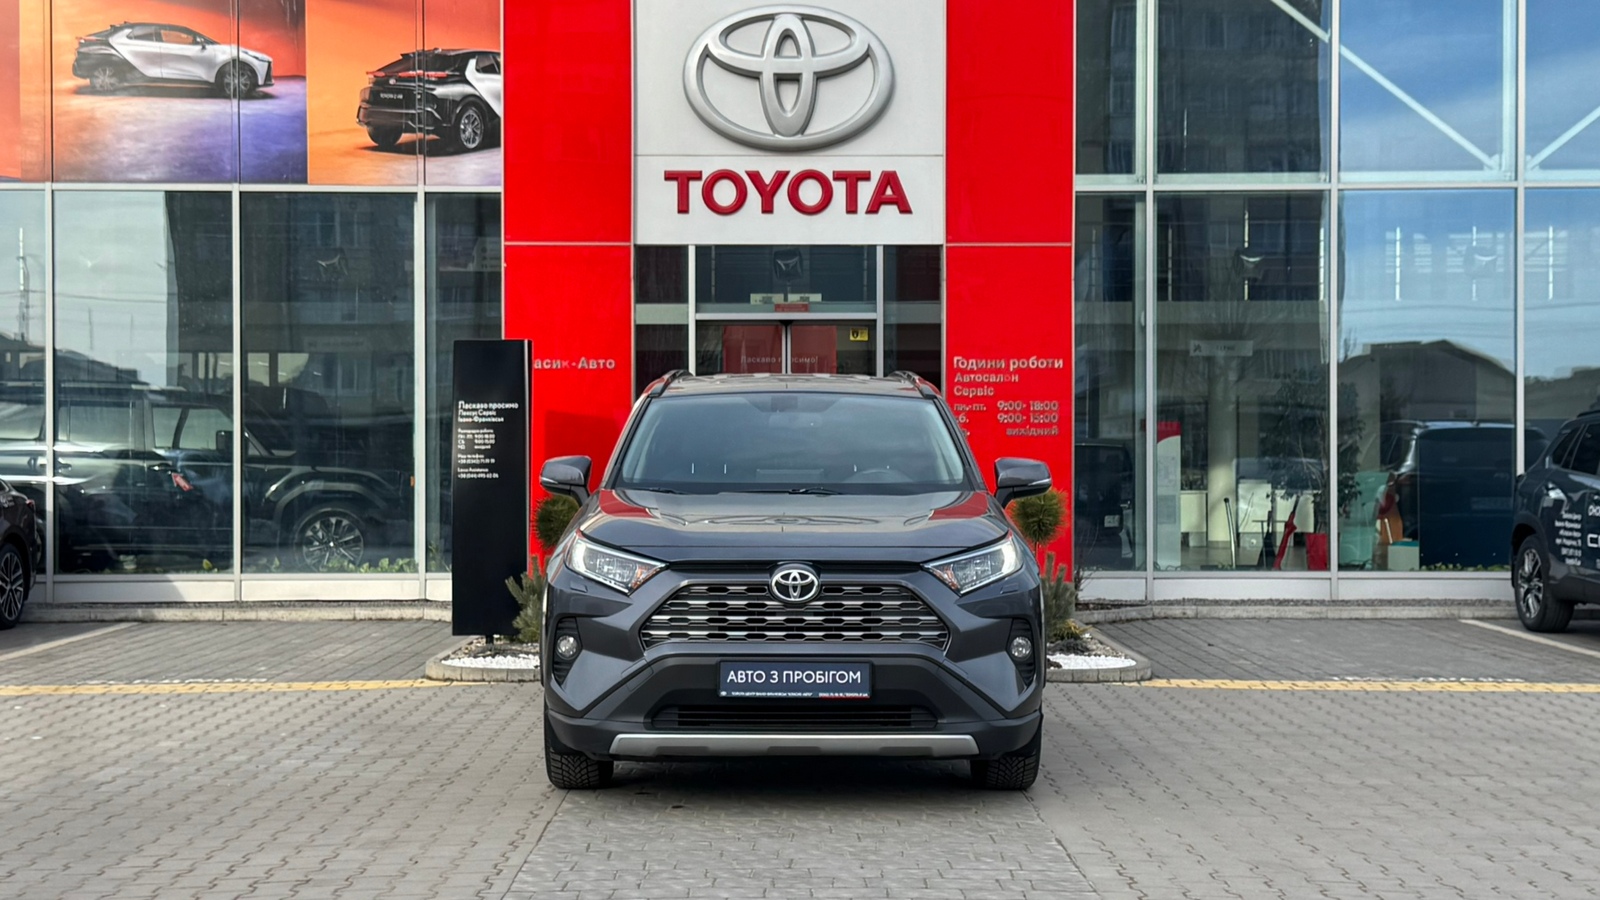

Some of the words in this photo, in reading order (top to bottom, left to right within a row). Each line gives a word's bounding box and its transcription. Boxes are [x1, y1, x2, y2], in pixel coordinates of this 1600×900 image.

[664, 169, 913, 216] TOYOTA
[534, 356, 616, 369] асик-Авто
[953, 356, 1005, 370] Години
[1009, 355, 1064, 371] роботи
[954, 372, 1019, 383] Автосалон
[954, 385, 995, 398] Сервіс
[726, 670, 766, 684] АВТО
[769, 670, 779, 684] З
[782, 670, 861, 684] ПРОБІГОМ
